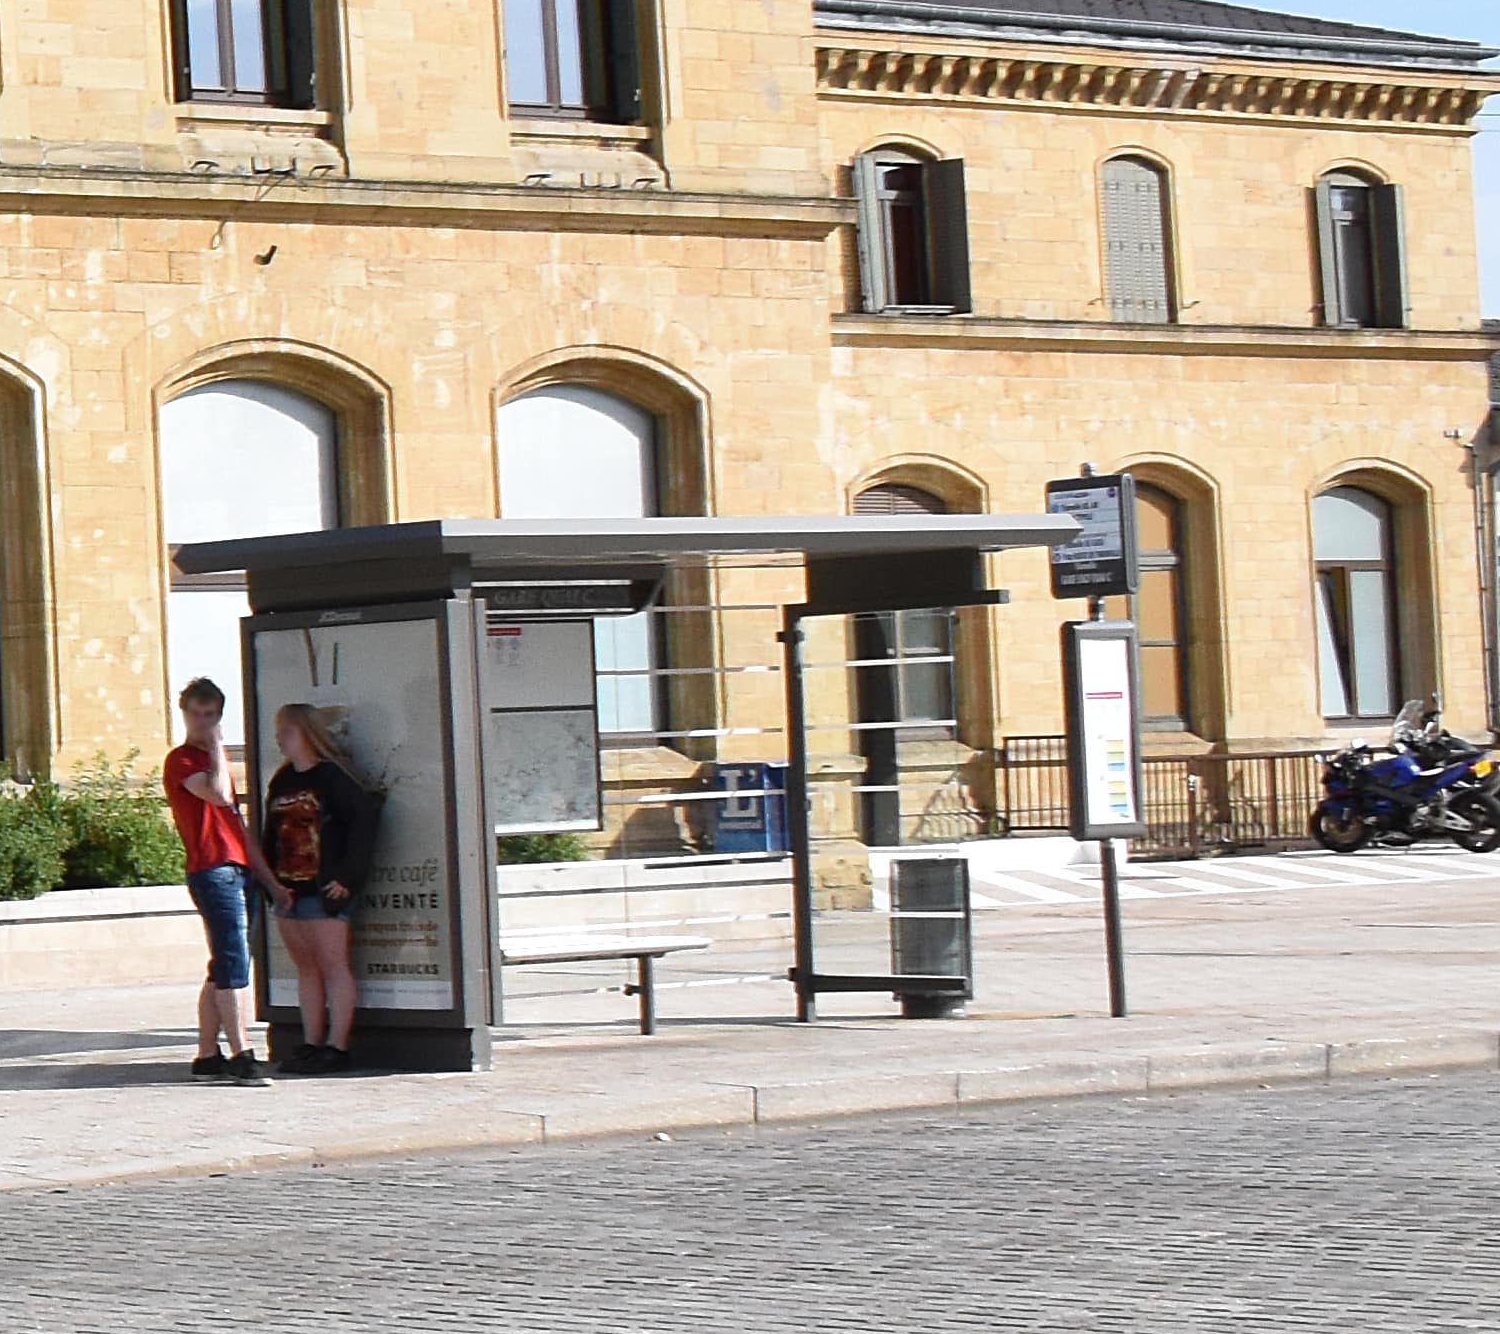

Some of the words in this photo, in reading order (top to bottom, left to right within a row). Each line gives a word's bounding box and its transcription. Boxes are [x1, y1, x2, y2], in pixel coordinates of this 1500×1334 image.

[370, 865, 395, 882] tre
[361, 891, 438, 908] NVENTÉ
[367, 964, 439, 974] STARBUCKS
